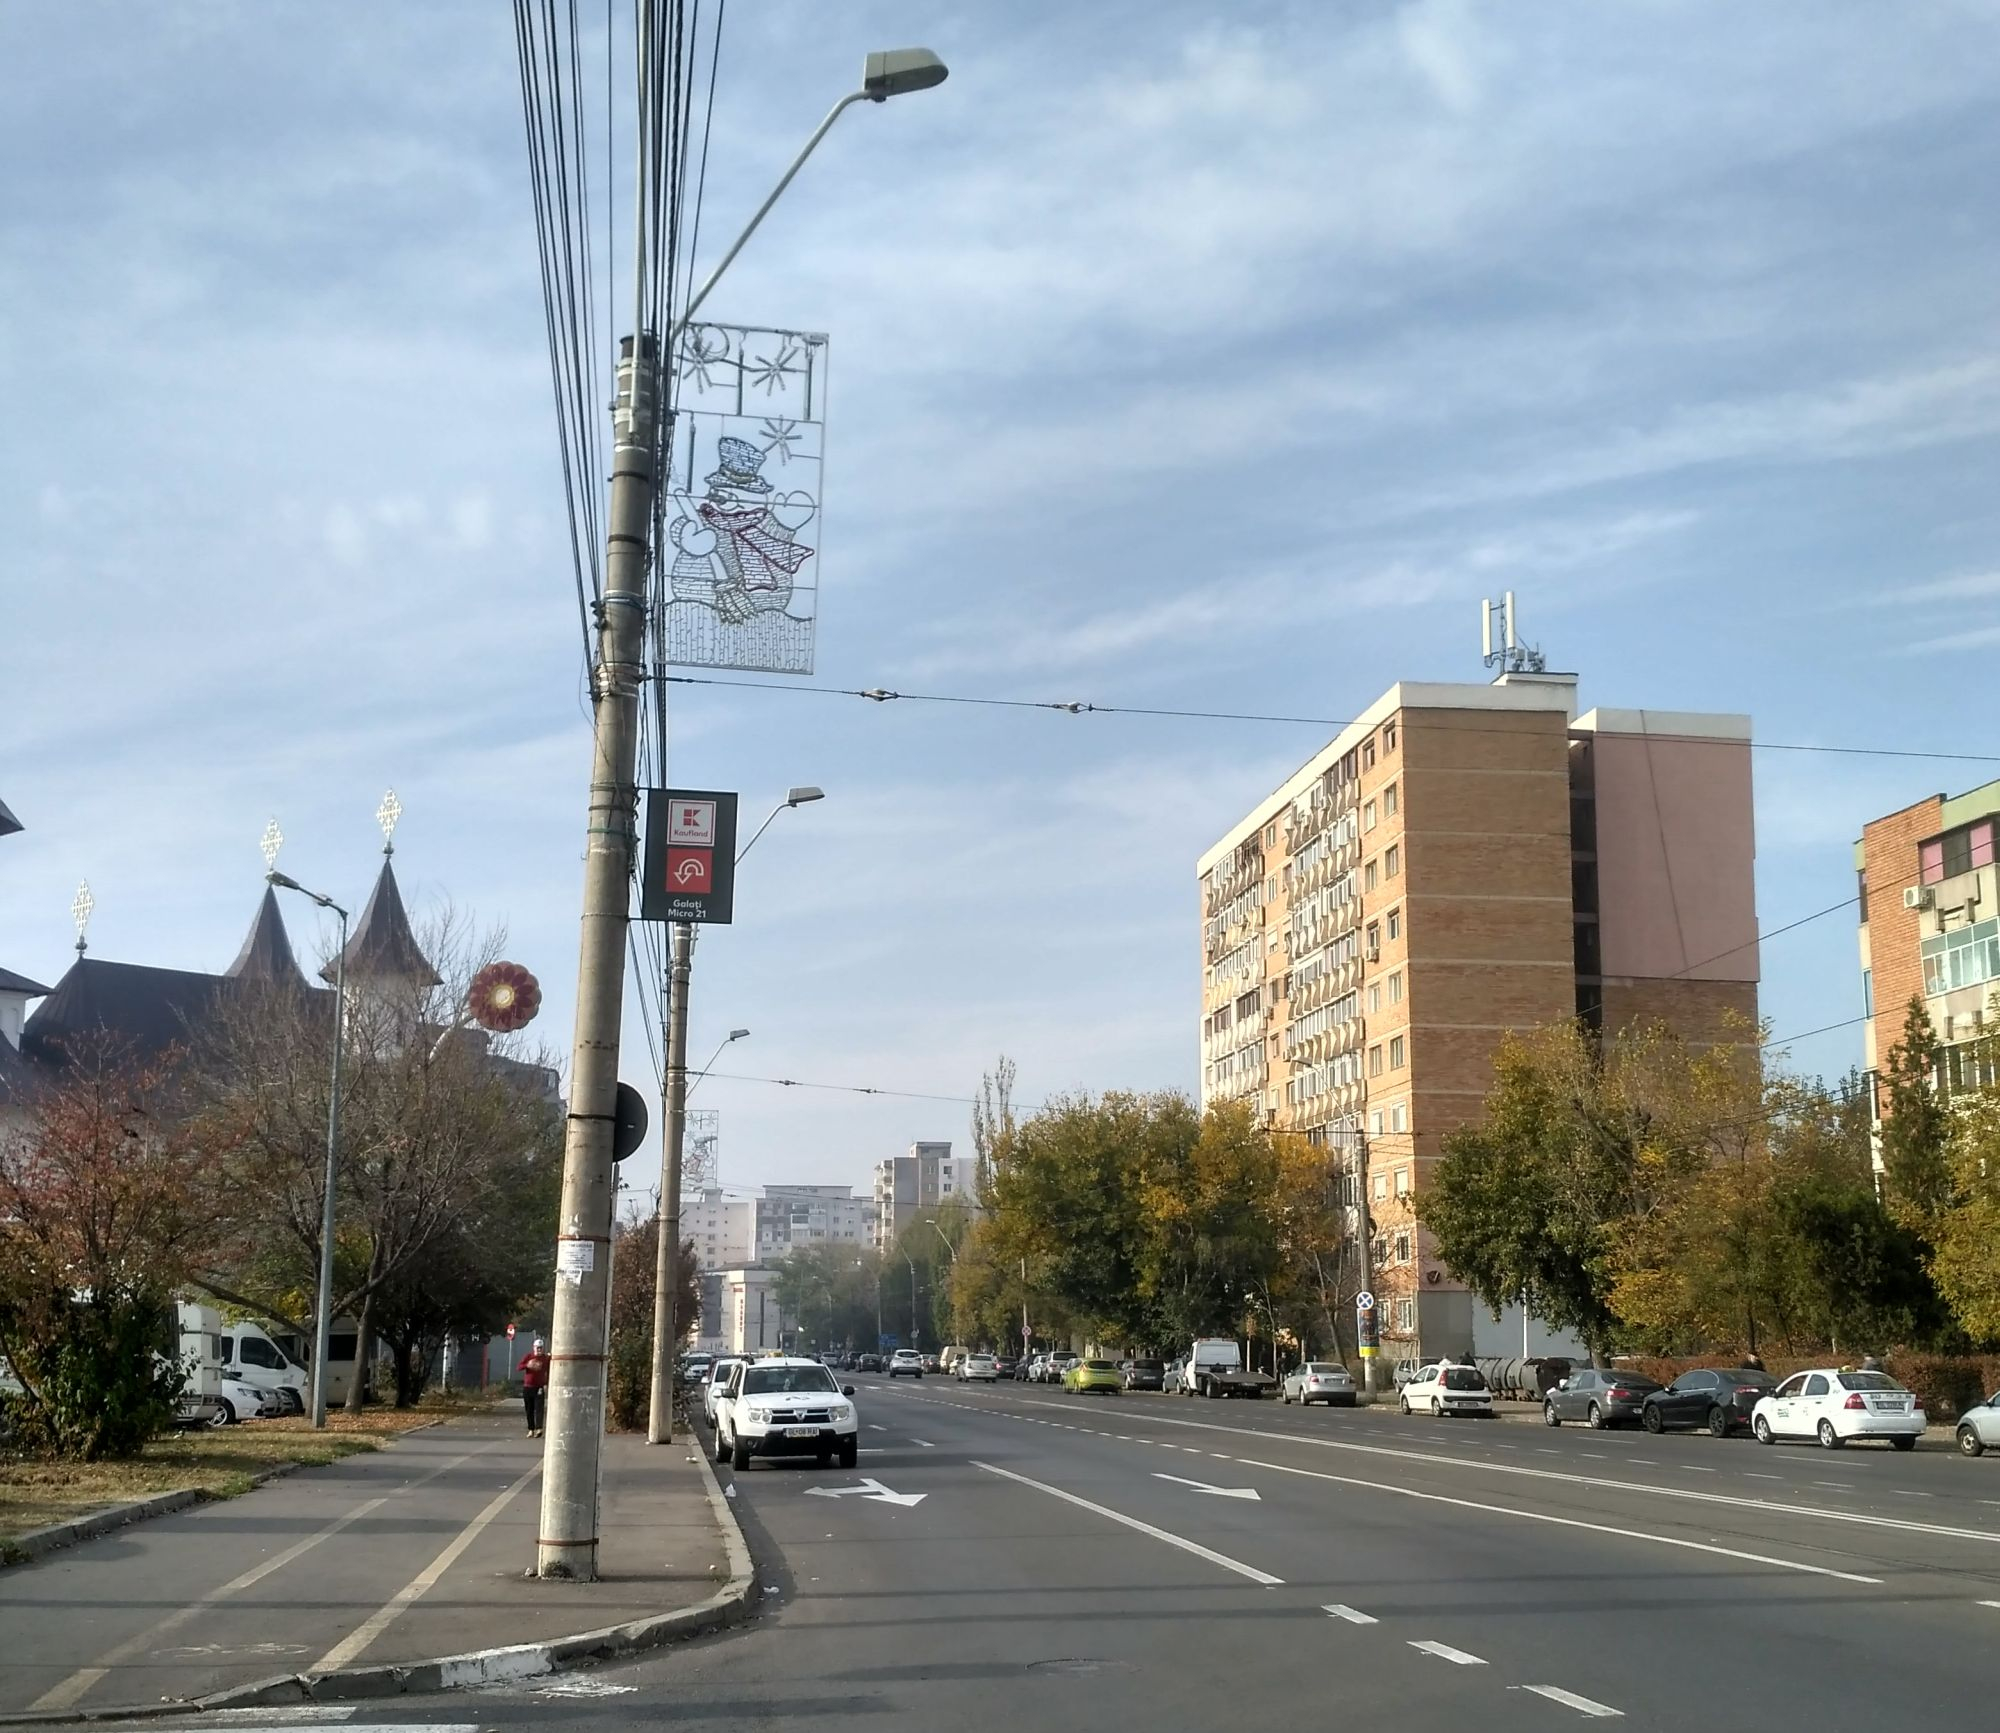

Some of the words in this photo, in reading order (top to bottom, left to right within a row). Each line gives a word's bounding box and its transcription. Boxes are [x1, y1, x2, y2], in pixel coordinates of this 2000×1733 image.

[674, 829, 708, 838] Kaufland
[668, 909, 694, 918] Micro
[696, 910, 706, 918] 21
